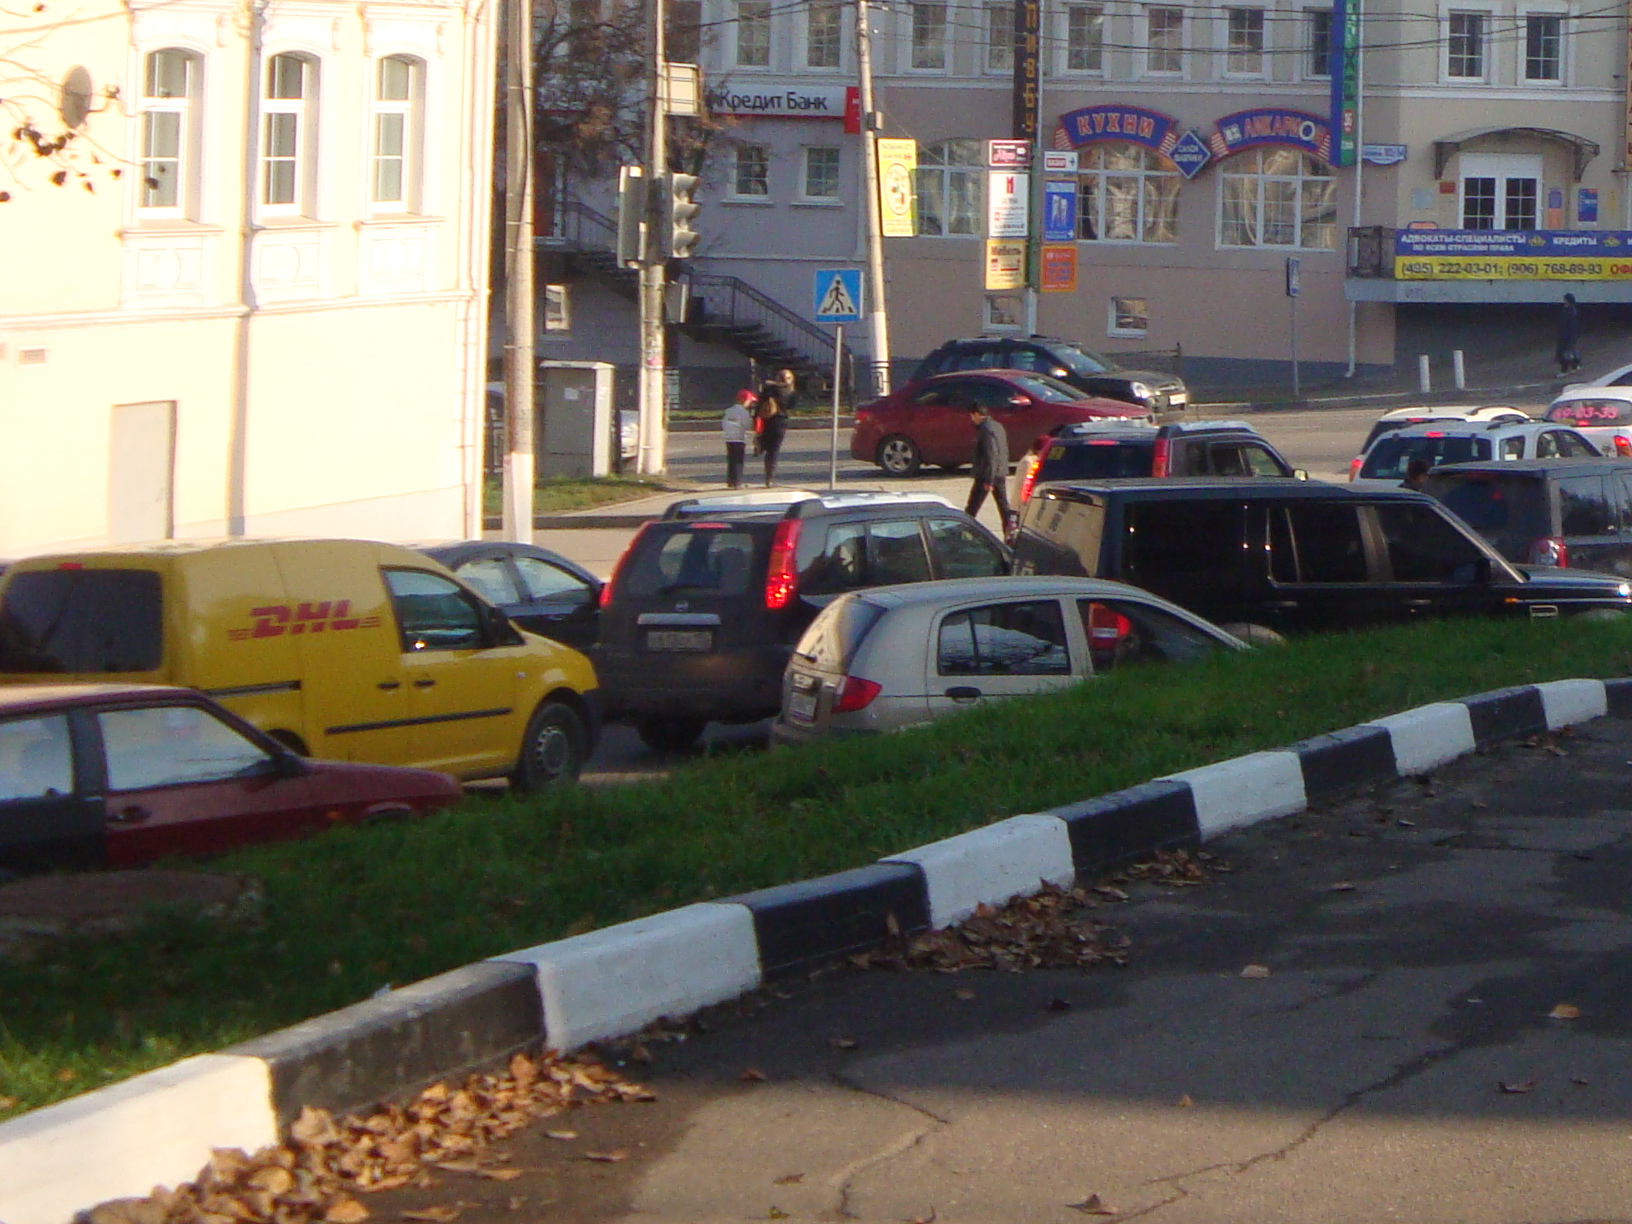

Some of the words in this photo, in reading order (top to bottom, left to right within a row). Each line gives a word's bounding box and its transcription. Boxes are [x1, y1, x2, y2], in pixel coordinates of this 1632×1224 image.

[1025, 3, 1037, 145] ПИВБУ
[786, 92, 828, 110] Банк
[1077, 112, 1155, 138] КУХНИ
[1401, 235, 1526, 244] АДВОКАТЫ-СПЕЦИАЛИСТЫ
[1553, 237, 1597, 246] КРЕДИТЫ
[1401, 262, 1434, 276] (495)
[1507, 262, 1538, 276] (906)
[250, 599, 361, 638] DHL
